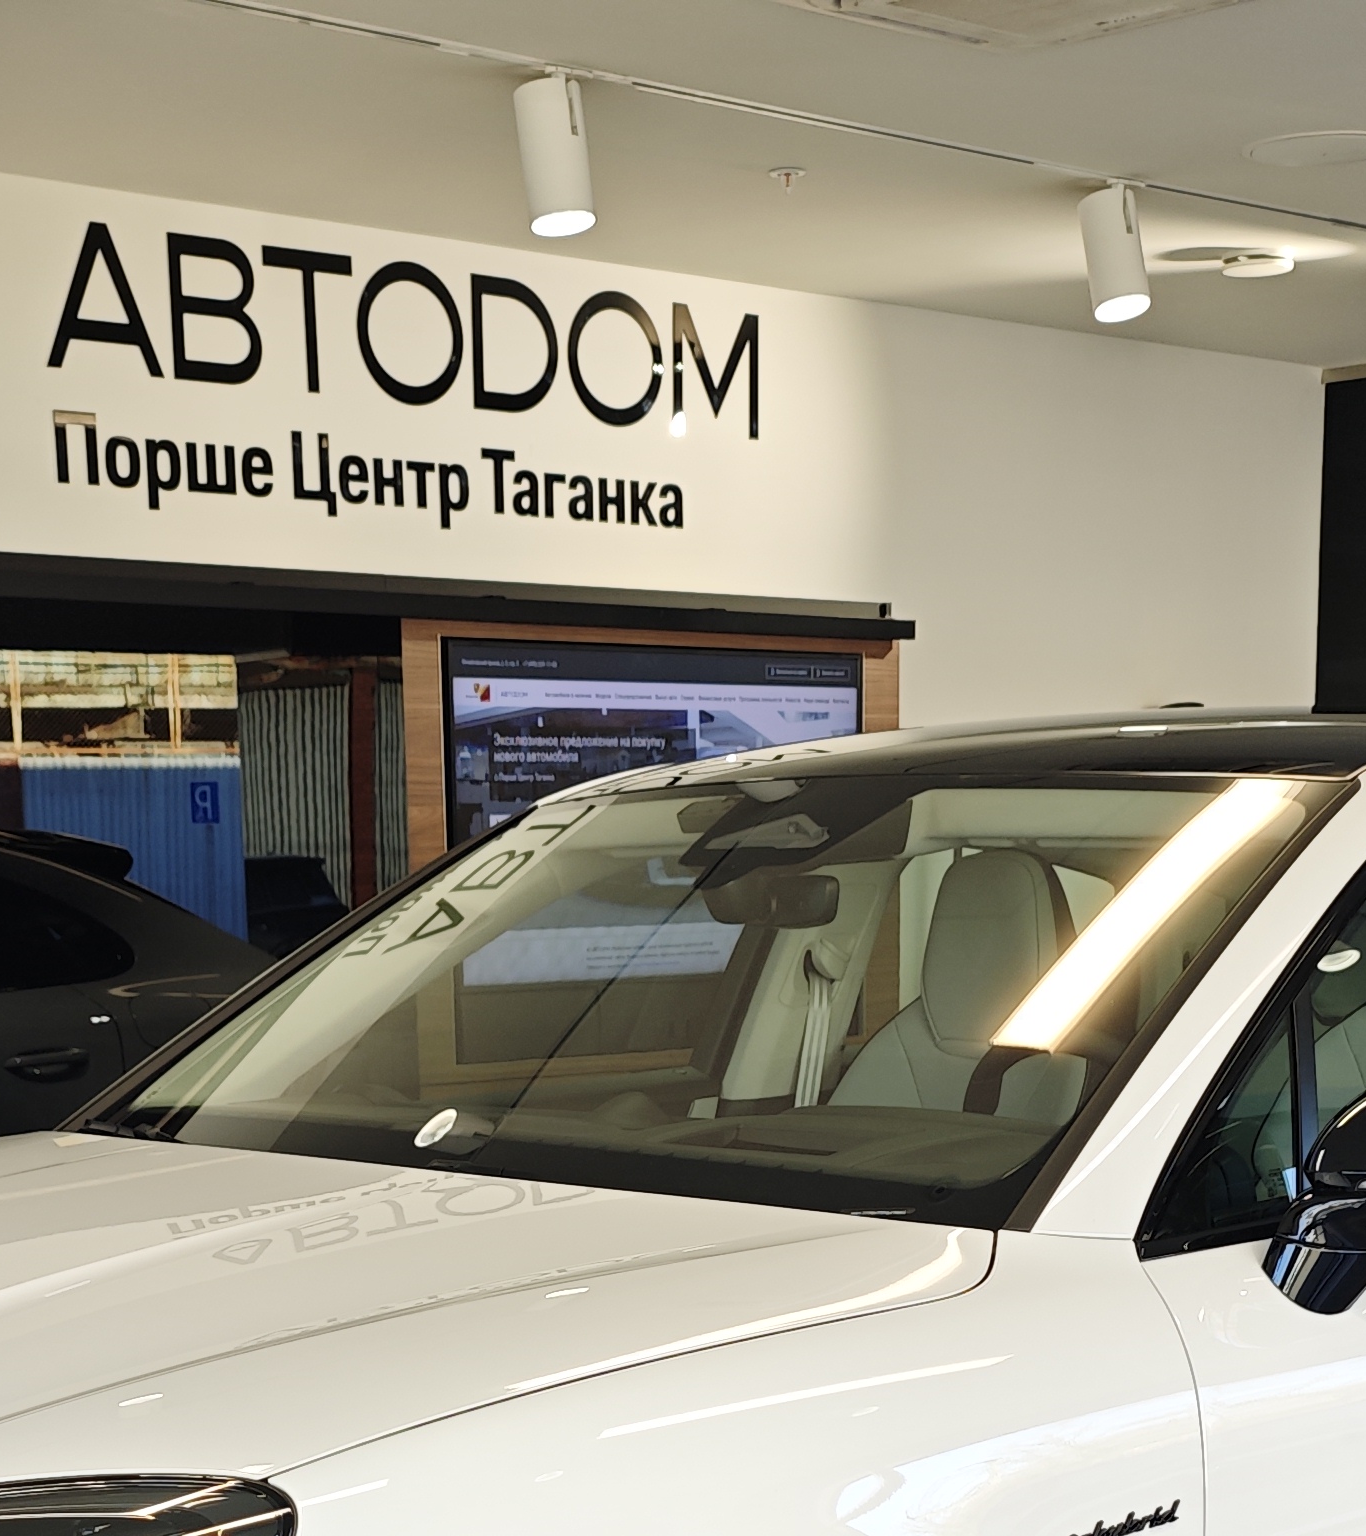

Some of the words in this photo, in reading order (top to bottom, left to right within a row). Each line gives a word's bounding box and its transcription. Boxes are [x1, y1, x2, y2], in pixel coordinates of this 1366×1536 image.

[51, 409, 274, 510] Порше
[291, 430, 470, 530] Центр
[481, 447, 685, 529] Таганка
